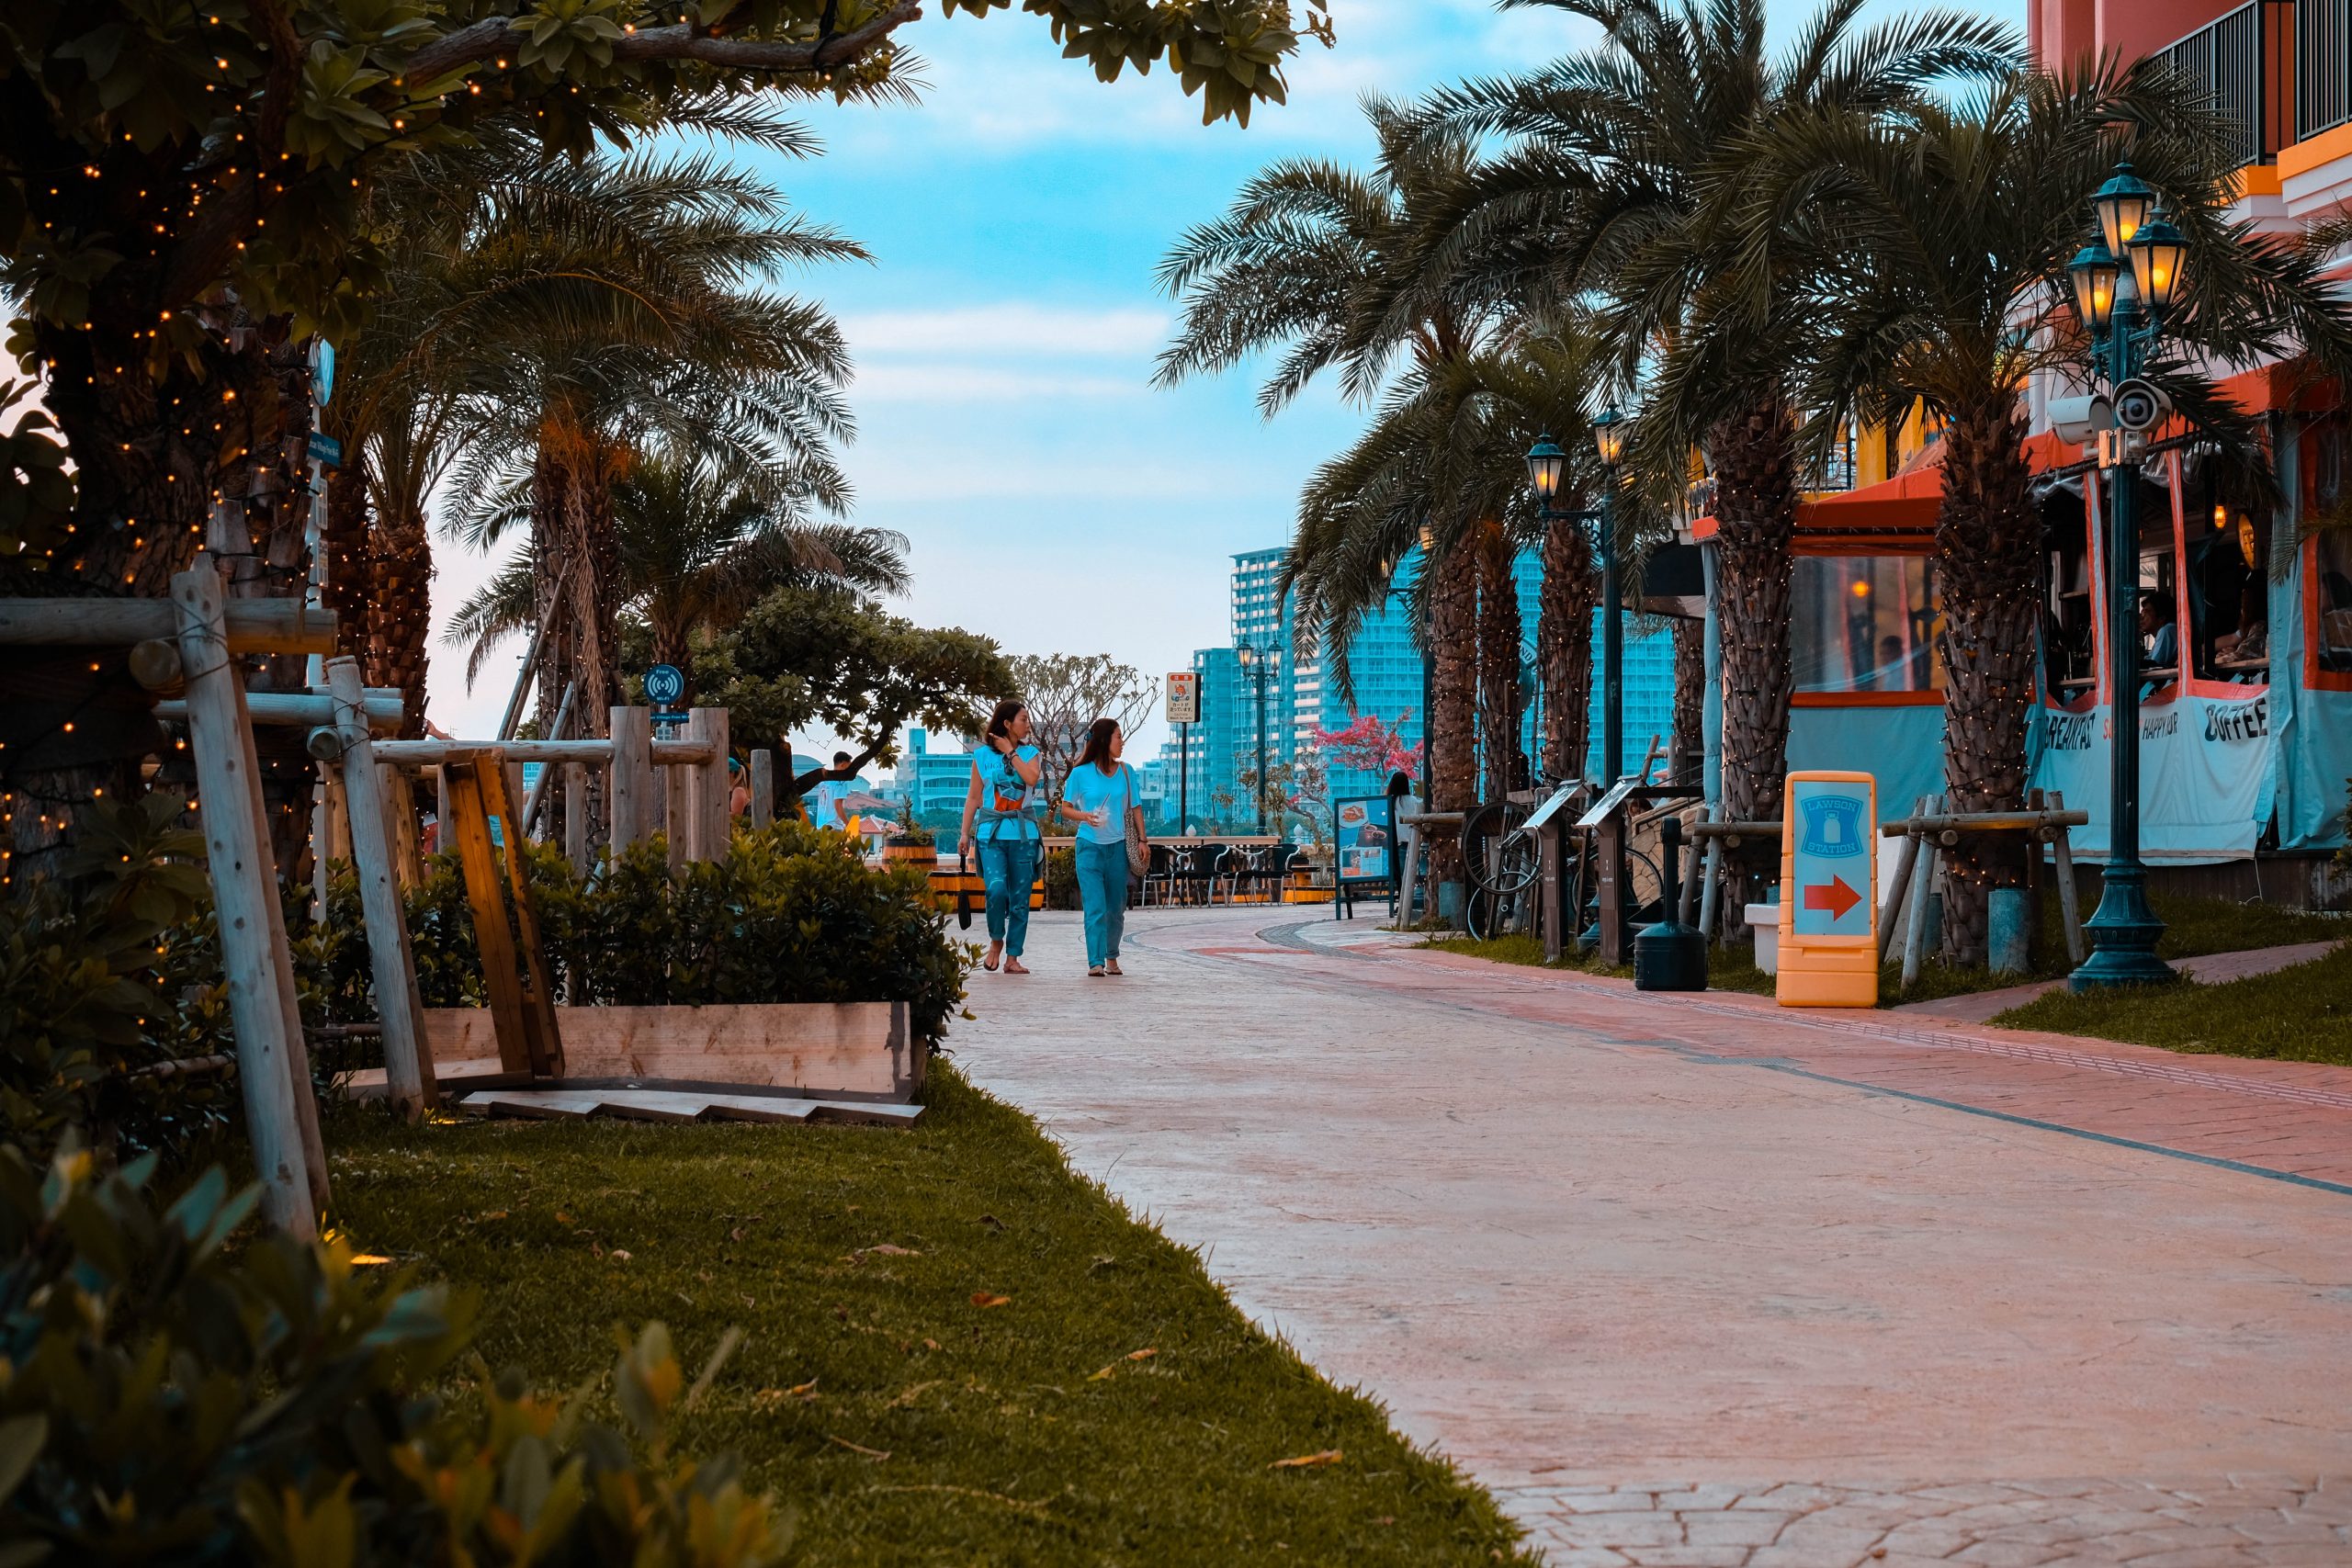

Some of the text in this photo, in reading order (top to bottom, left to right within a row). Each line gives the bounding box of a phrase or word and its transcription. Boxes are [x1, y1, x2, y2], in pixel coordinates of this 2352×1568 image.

[2204, 697, 2268, 742] COFFEE
[1807, 800, 1857, 812] LAWSON
[1807, 841, 1857, 853] STATION
